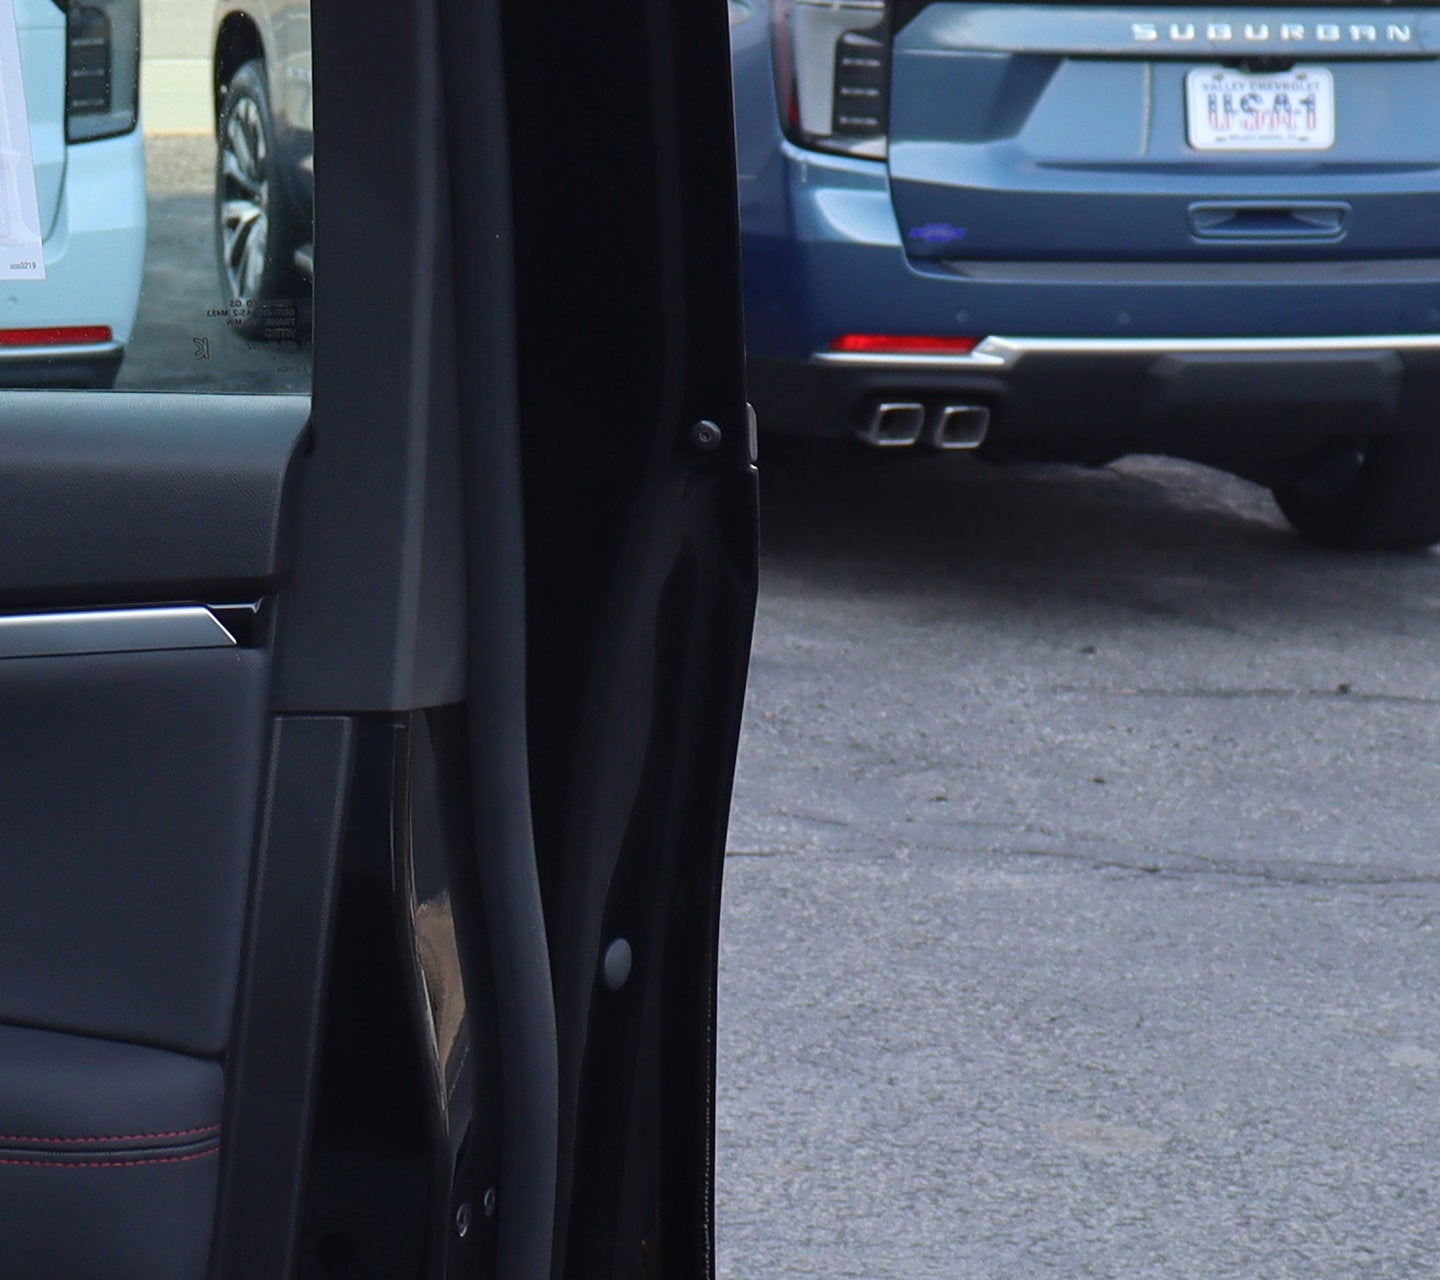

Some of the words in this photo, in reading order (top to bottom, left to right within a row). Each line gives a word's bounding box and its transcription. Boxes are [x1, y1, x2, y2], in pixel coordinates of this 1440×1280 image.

[1131, 23, 1410, 41] SUBURBAN
[1203, 82, 1246, 92] VALLEY
[1250, 81, 1320, 91] CHEVROLET
